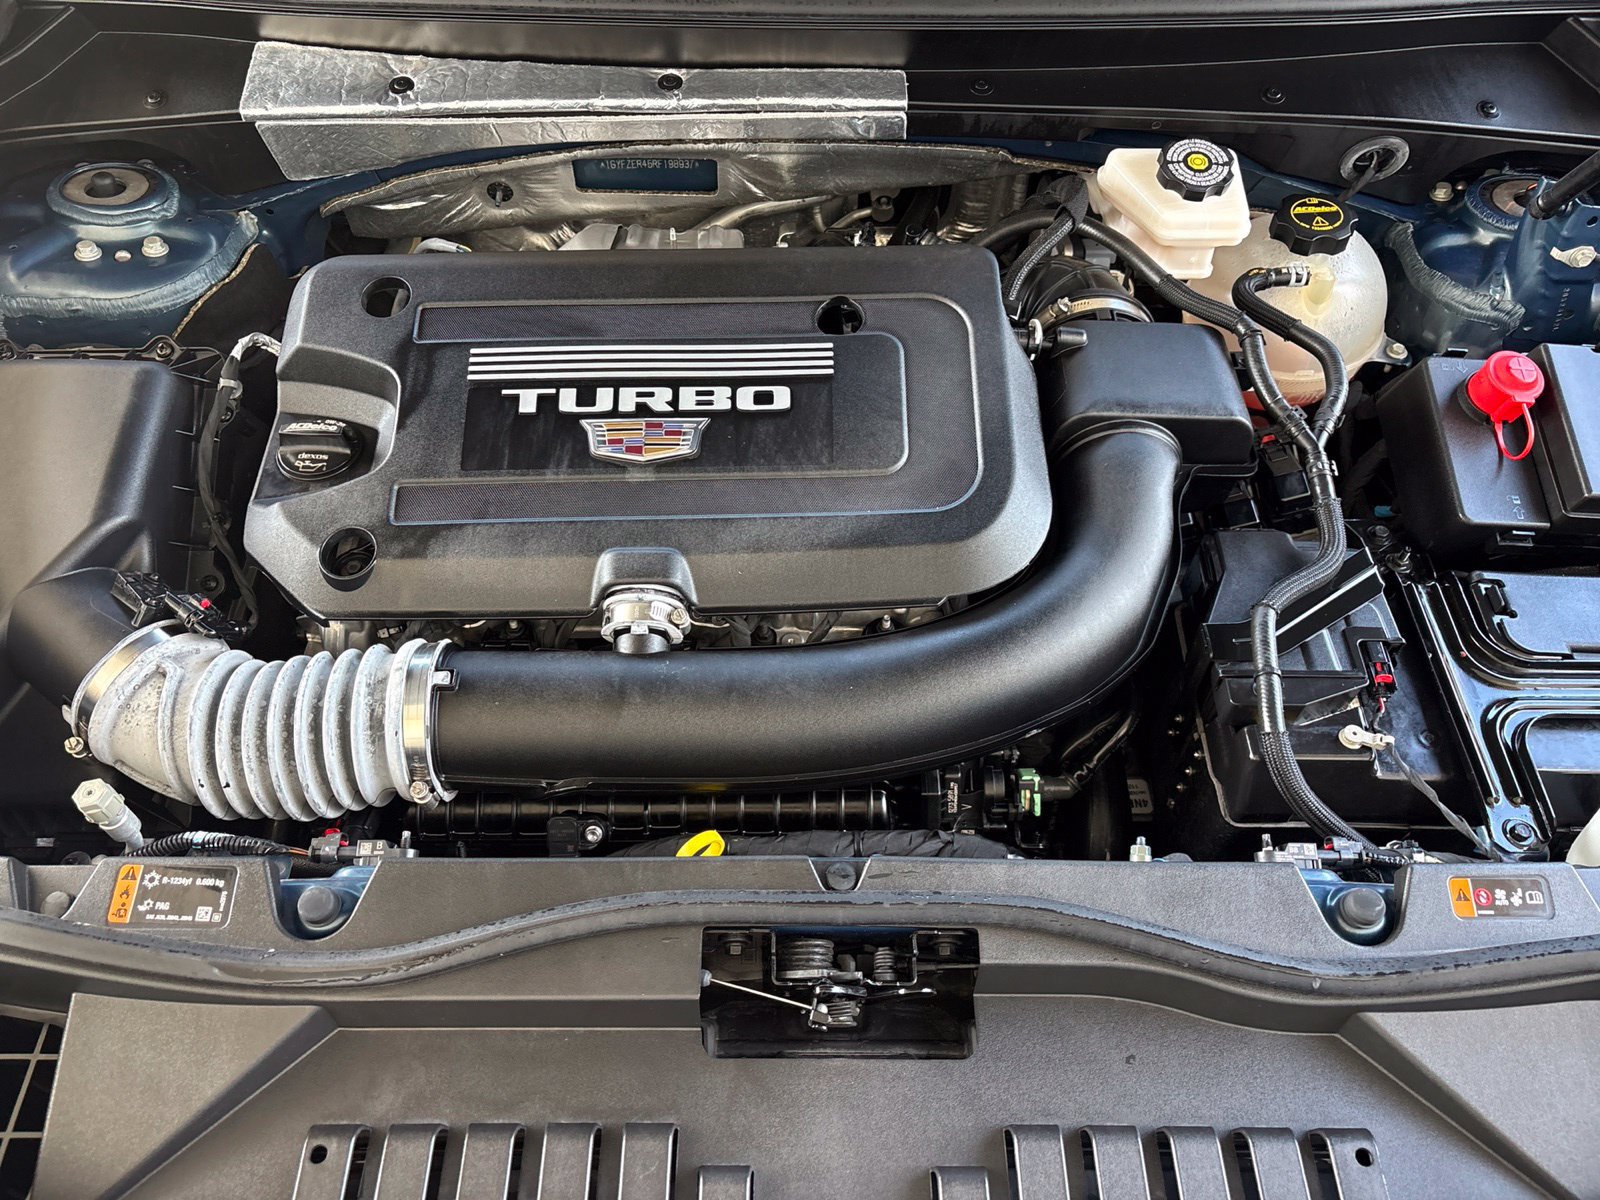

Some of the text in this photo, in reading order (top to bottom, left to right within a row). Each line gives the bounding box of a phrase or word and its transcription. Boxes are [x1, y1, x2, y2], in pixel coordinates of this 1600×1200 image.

[1293, 205, 1338, 214] ACDelco
[501, 385, 792, 415] TURBO
[284, 422, 338, 432] ACDelco
[298, 452, 329, 460] dexos
[161, 875, 225, 888] R-1234yf 0.600 kg
[154, 901, 170, 910] PAG
